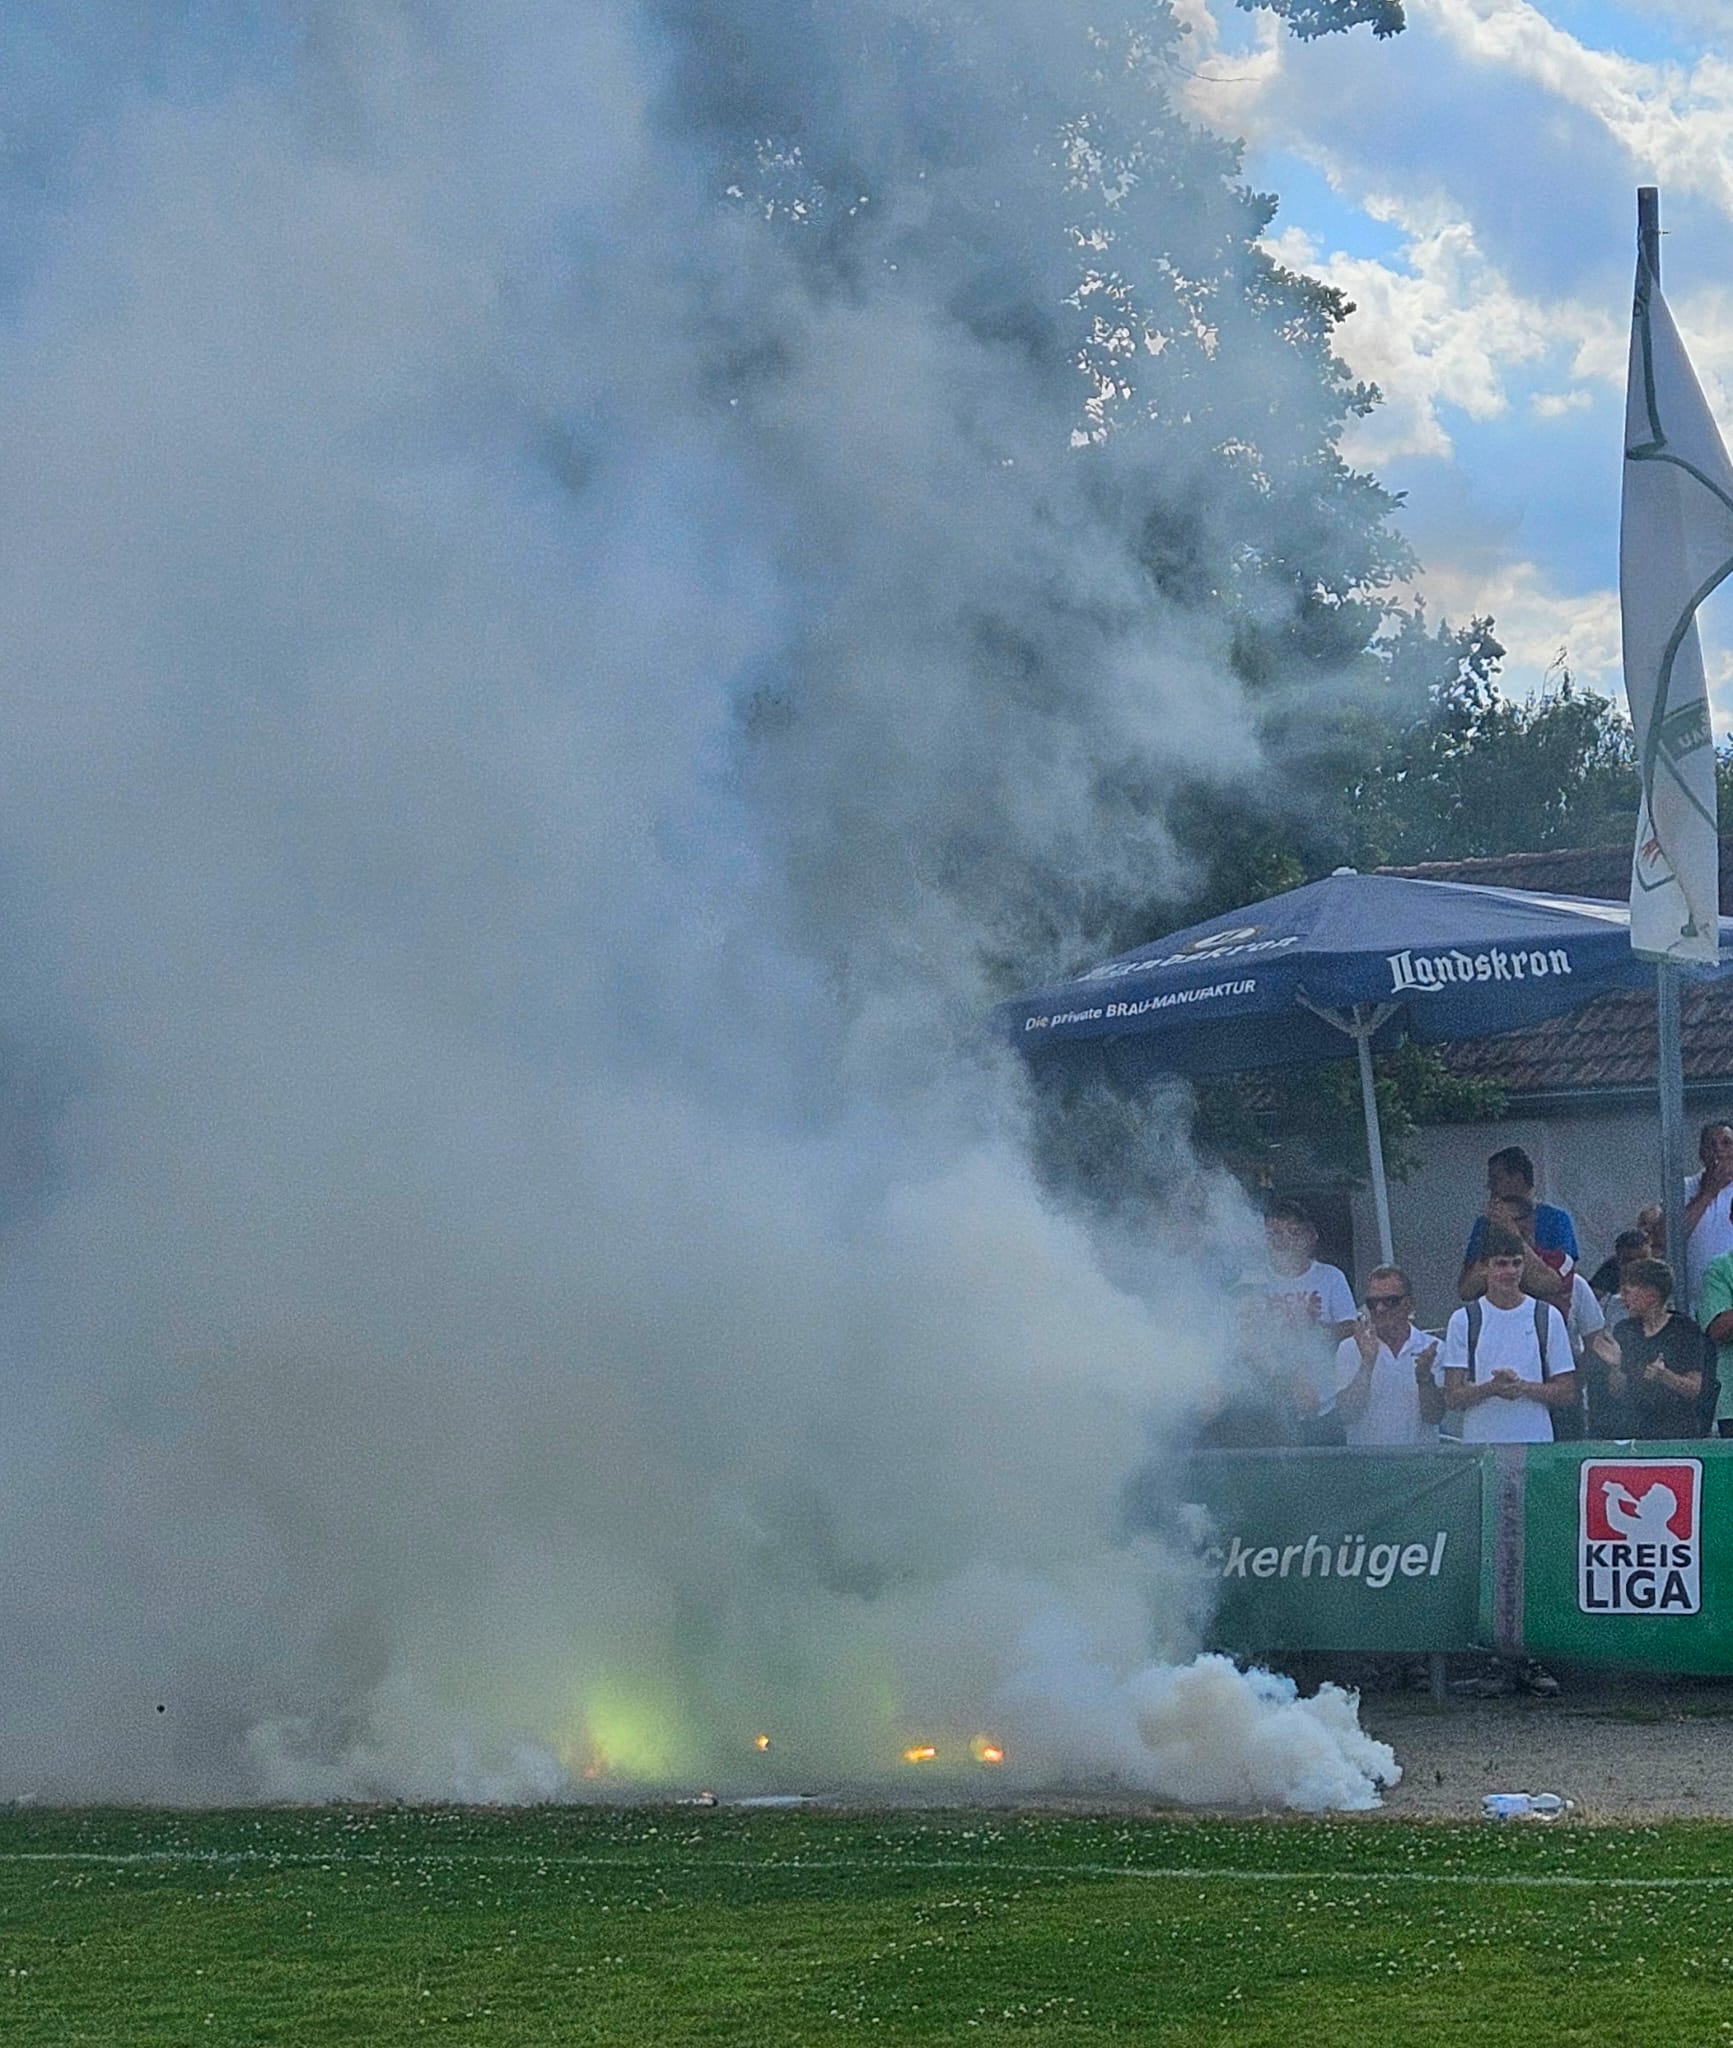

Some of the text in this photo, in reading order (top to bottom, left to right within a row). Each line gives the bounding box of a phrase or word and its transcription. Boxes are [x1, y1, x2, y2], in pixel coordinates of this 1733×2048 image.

[1386, 946, 1572, 994] Landskron
[1024, 979, 1257, 1032] Die private BRAU-MANUFAKTUR
[1586, 1543, 1692, 1568] KREIS
[1586, 1569, 1693, 1609] LIGA
